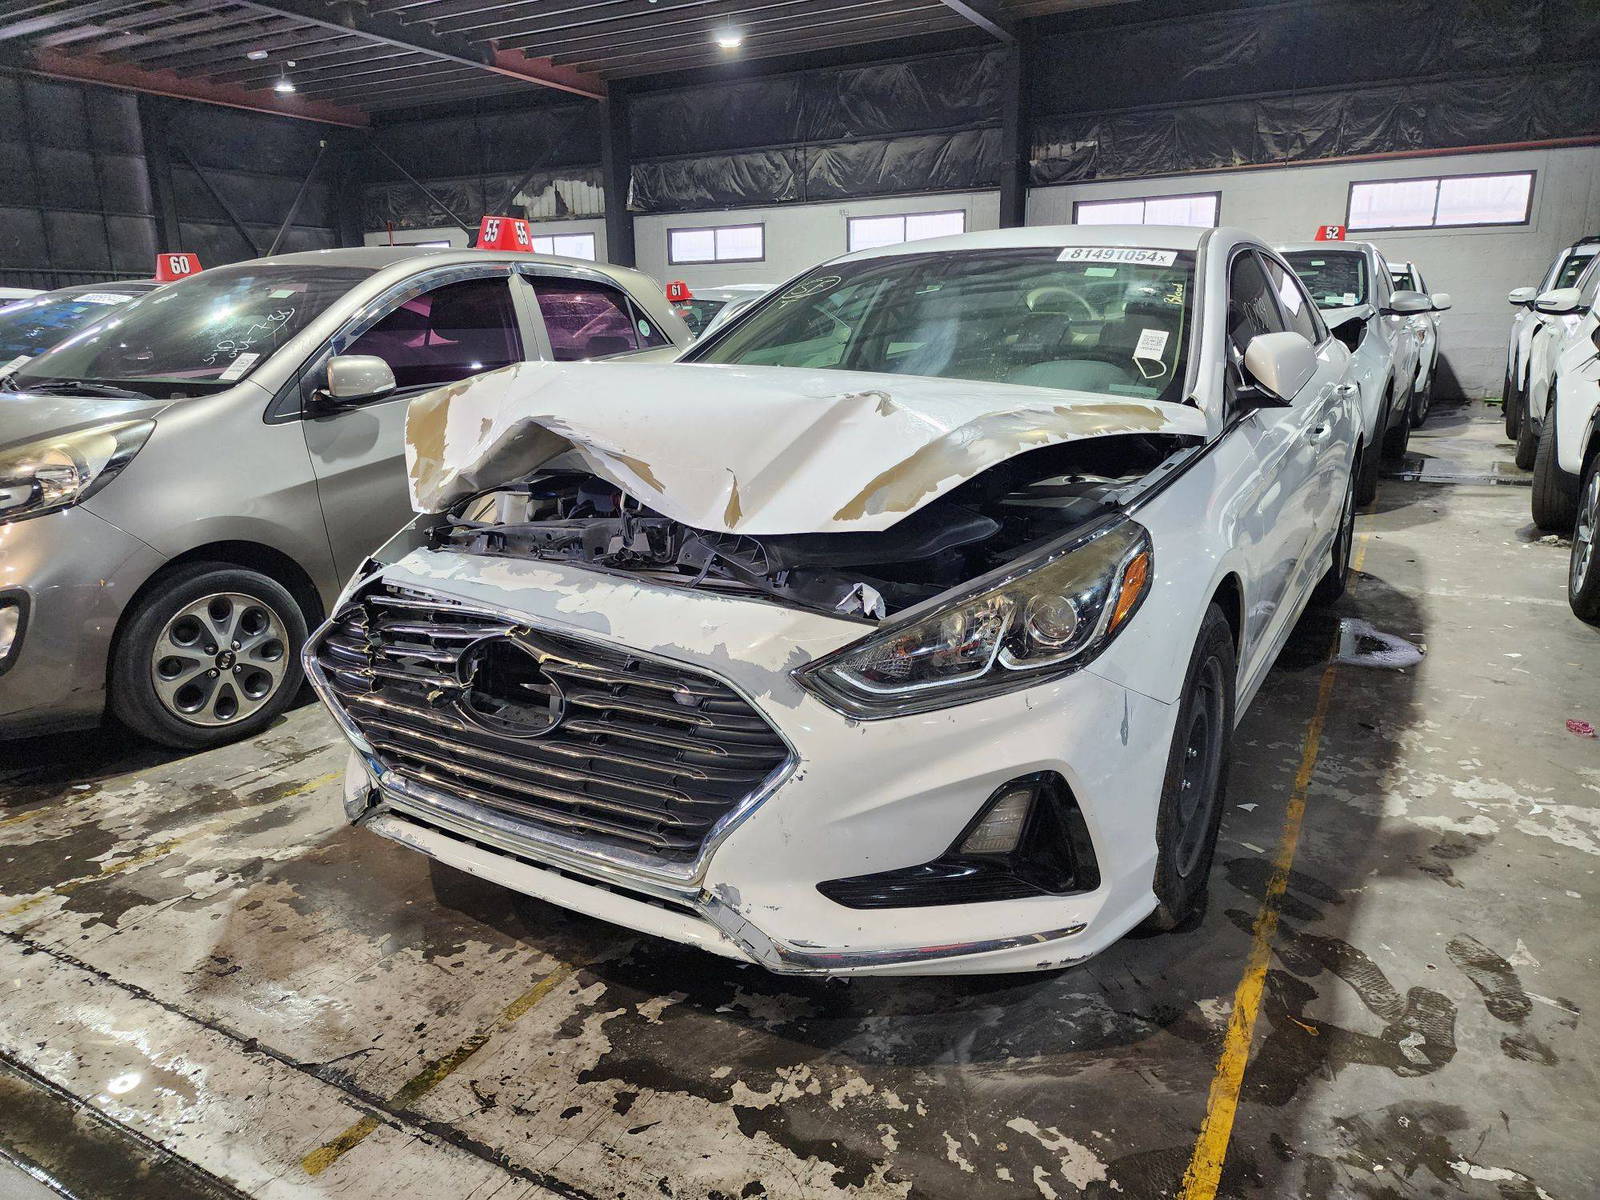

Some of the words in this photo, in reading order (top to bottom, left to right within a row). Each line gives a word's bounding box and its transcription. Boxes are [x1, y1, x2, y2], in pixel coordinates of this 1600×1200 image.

[484, 219, 500, 242] 55
[514, 221, 529, 245] 55
[1326, 227, 1340, 240] 52
[169, 255, 190, 275] 60
[671, 284, 682, 297] 61
